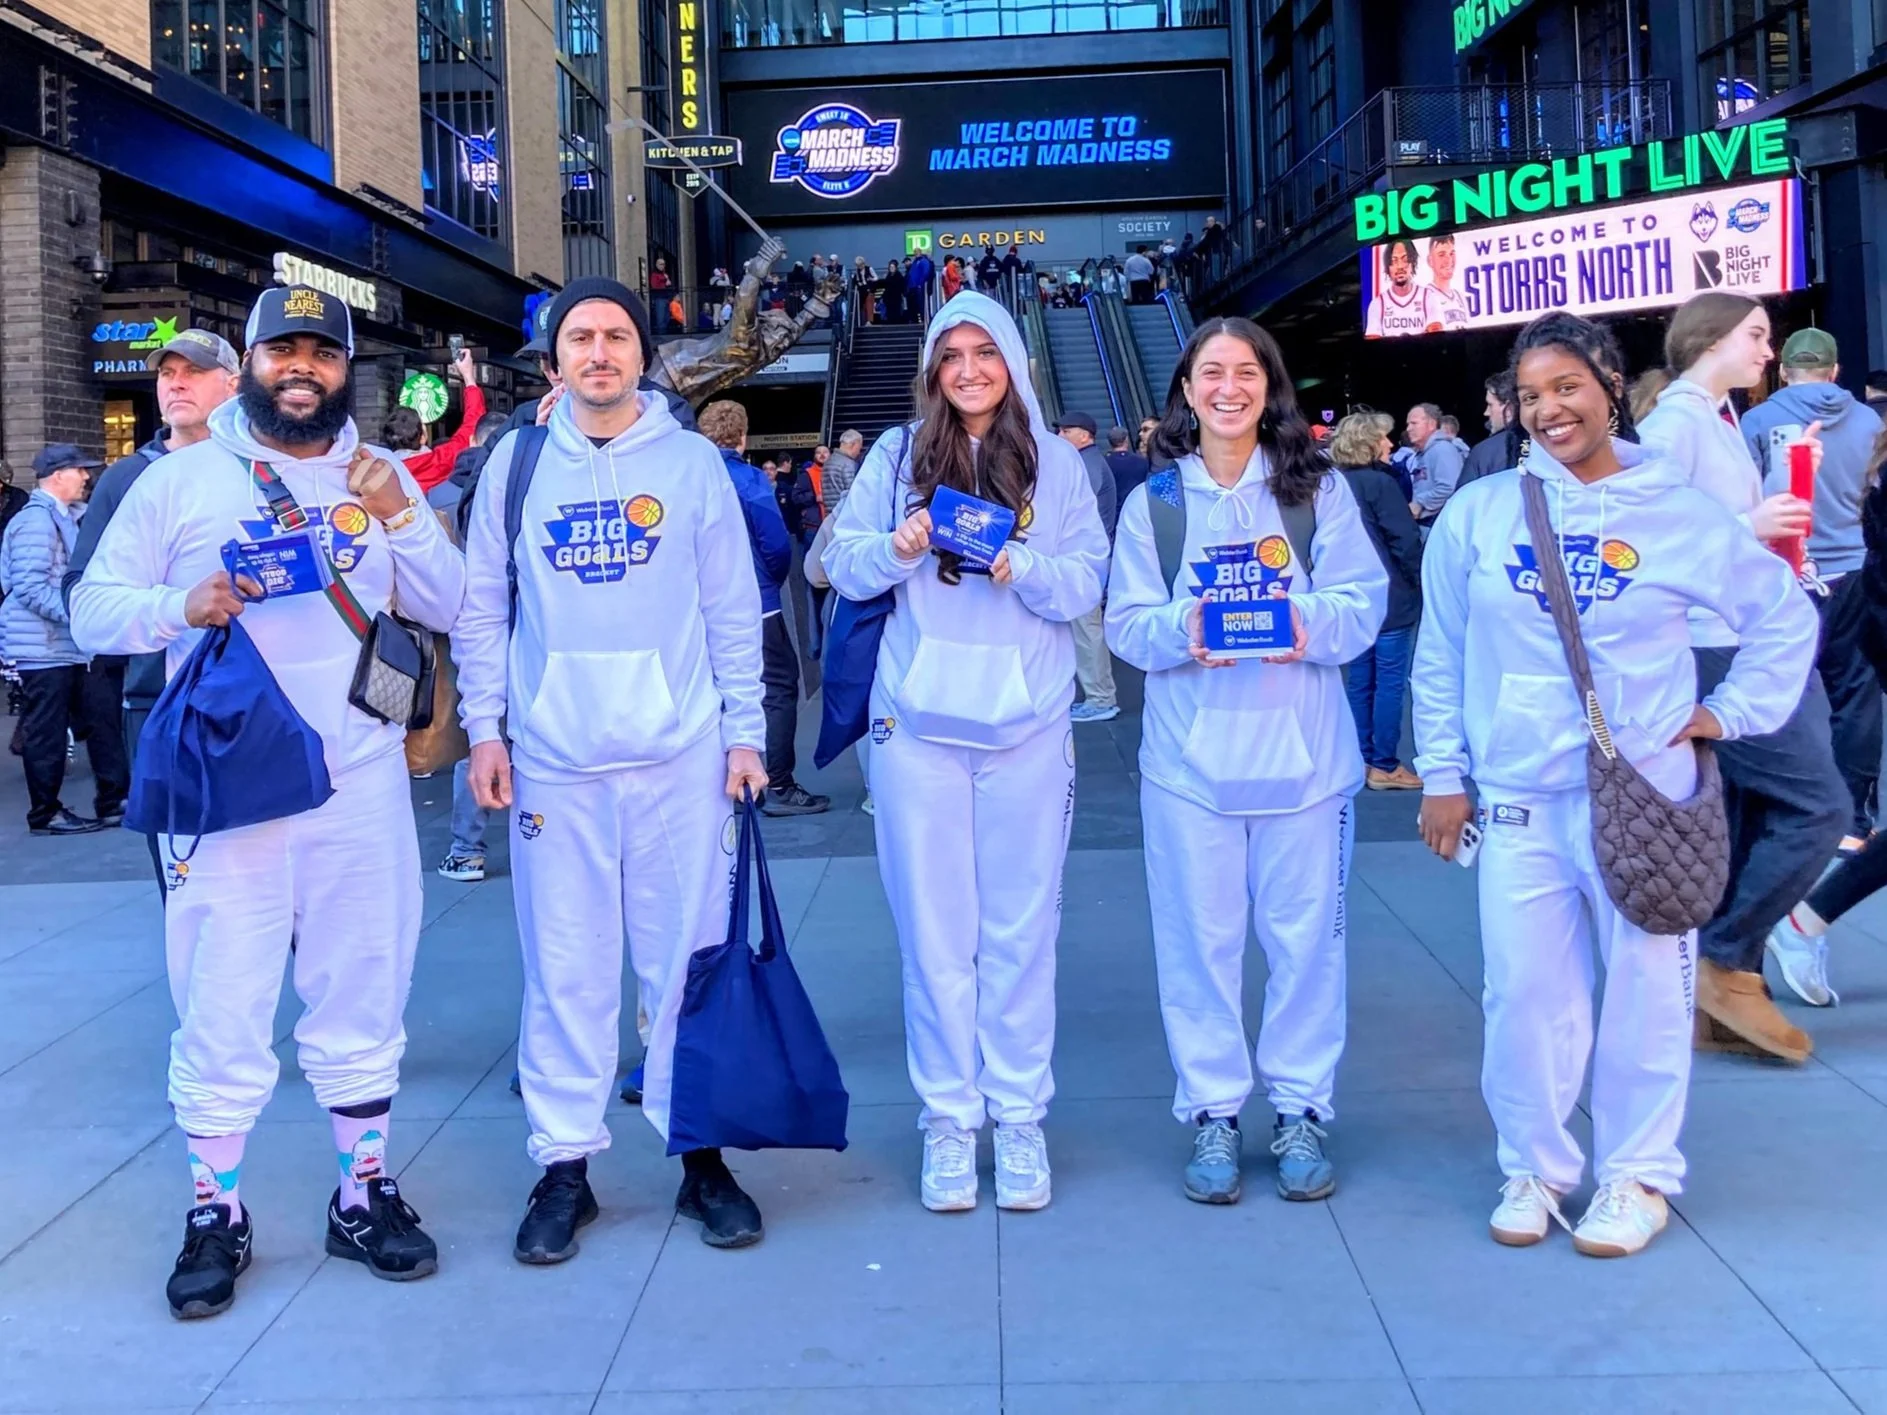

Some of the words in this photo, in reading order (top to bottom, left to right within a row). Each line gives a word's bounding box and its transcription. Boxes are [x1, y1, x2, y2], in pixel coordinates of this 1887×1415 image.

[801, 127, 865, 150] MARCH
[960, 118, 1094, 145] WELCOME
[1101, 116, 1137, 138] TO
[710, 145, 734, 156] TAP
[808, 146, 895, 169] MADNESS
[929, 146, 1028, 170] MARCH
[1036, 139, 1171, 166] MADNESS
[1401, 143, 1420, 152] PLAY
[1354, 184, 1439, 241] BIG
[1453, 146, 1632, 224] NIGHT
[1648, 118, 1790, 192] LIVE
[1118, 221, 1171, 233] SOCIETY
[1473, 222, 1606, 256] WELCOME
[1623, 214, 1658, 234] TO
[907, 234, 930, 250] TD
[938, 230, 1045, 249] GARDEN
[1726, 245, 1750, 260] BIG
[1726, 256, 1771, 273] NIGHT
[273, 252, 376, 312] STARBUCKS
[1464, 253, 1567, 318] STORRS
[1578, 237, 1673, 304] NORTH
[1727, 271, 1761, 286] LIVE
[290, 290, 320, 301] UNCLE
[284, 299, 325, 314] NEAREST
[92, 320, 156, 342] star
[1384, 317, 1424, 328] UCONN
[569, 518, 626, 544] BIG
[1214, 560, 1262, 586] BIG
[1222, 612, 1253, 621] ENTER
[1223, 620, 1253, 632] NOW
